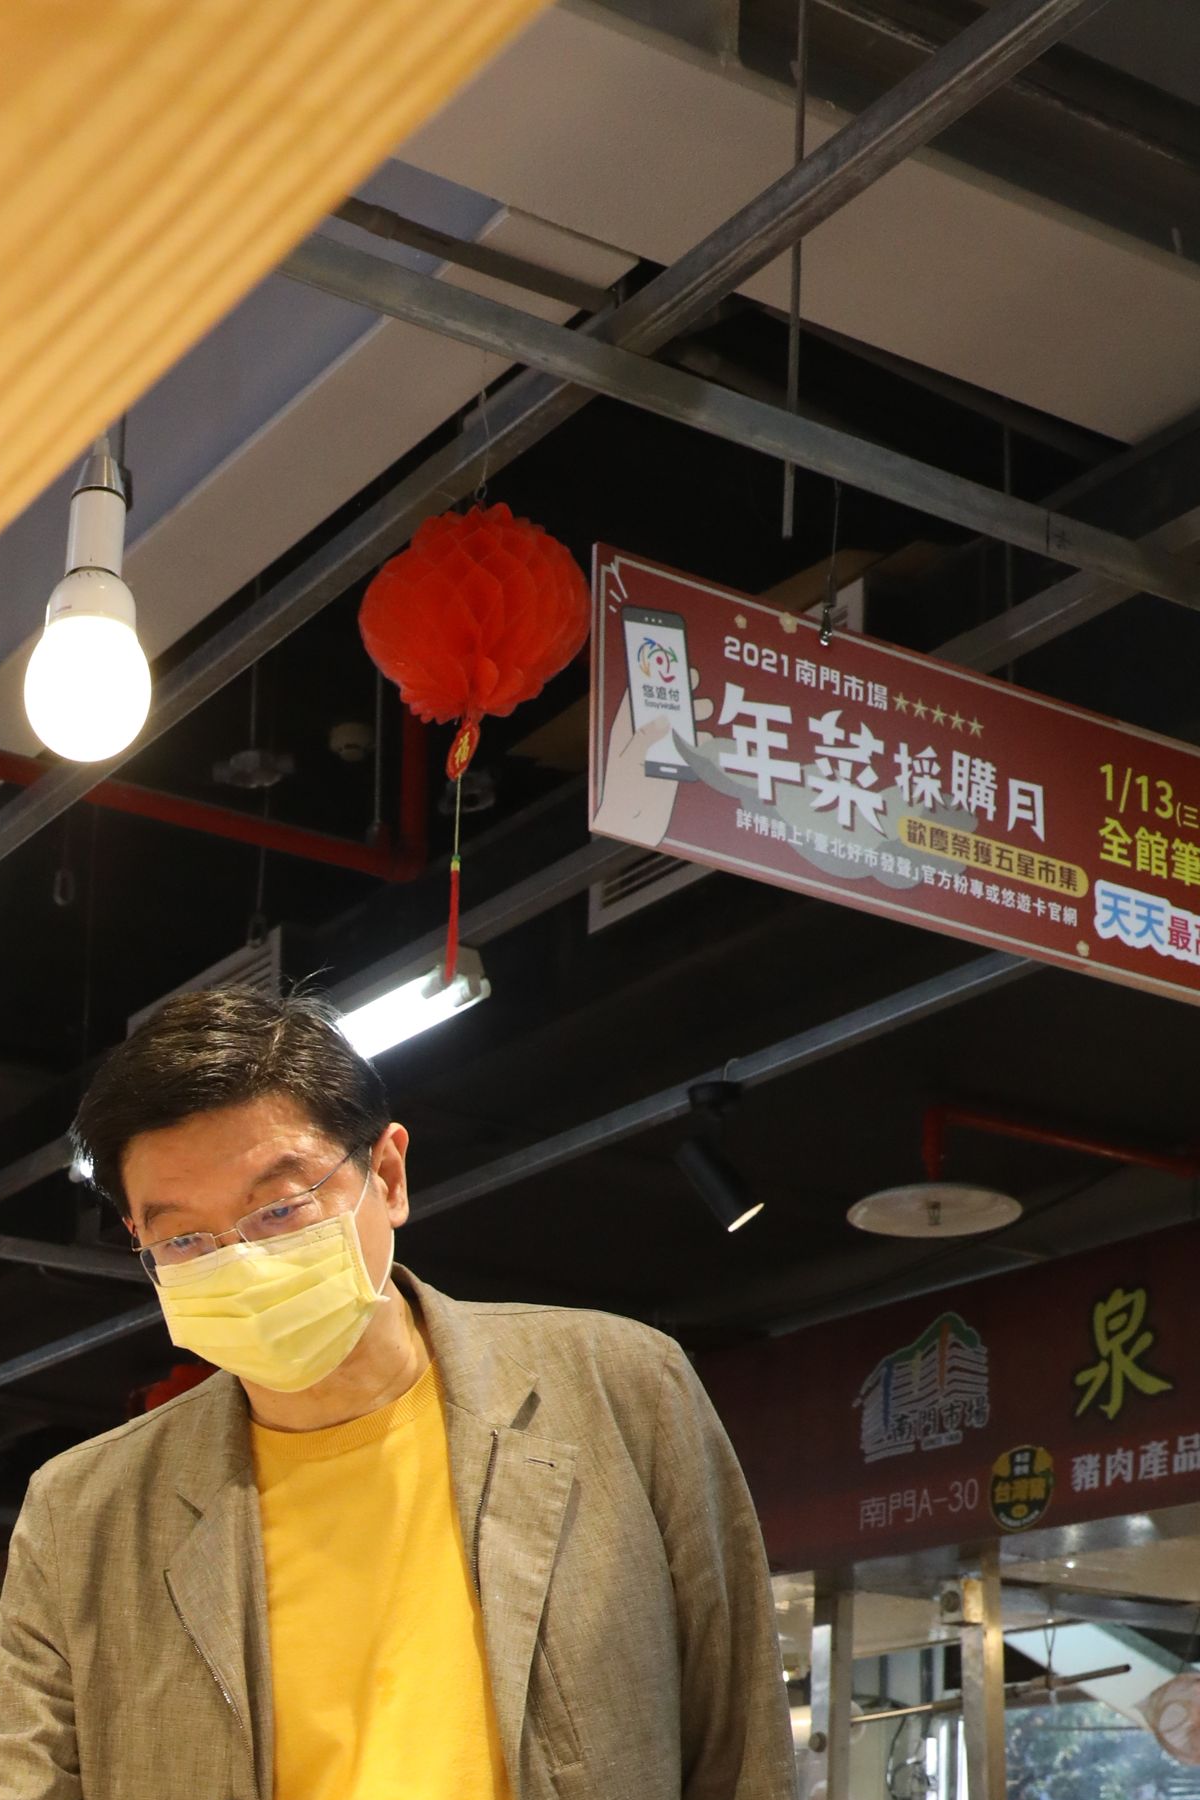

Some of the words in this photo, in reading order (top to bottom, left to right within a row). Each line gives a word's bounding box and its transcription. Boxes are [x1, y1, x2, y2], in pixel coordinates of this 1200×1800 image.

[723, 635, 889, 712] 2021南門市場
[717, 681, 1046, 843] 年菜採購月
[905, 818, 1079, 893] 歡慶榮獲五星市集
[1074, 1287, 1174, 1421] 泉
[858, 1477, 980, 1532] 南門A-30
